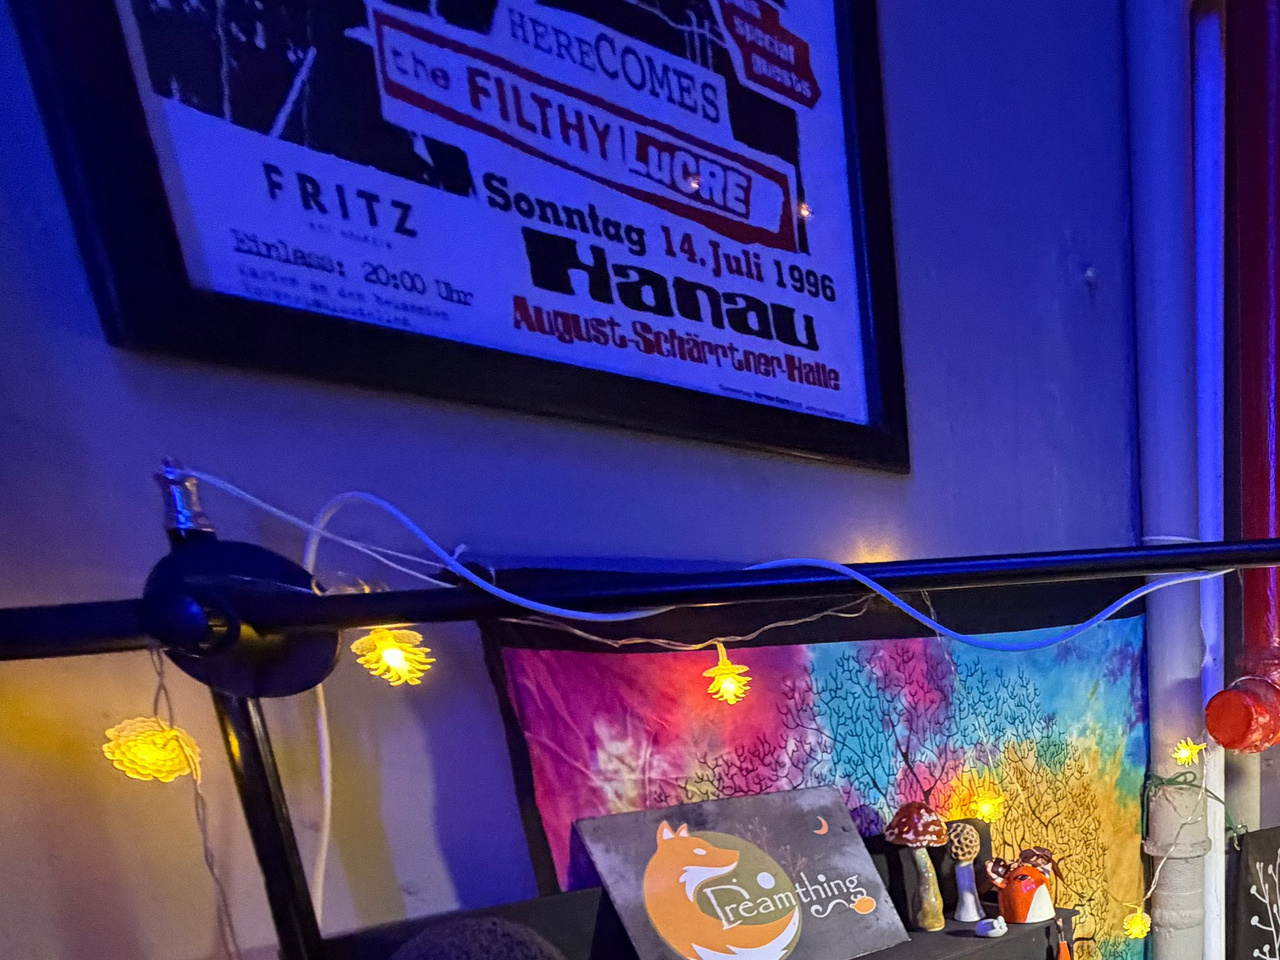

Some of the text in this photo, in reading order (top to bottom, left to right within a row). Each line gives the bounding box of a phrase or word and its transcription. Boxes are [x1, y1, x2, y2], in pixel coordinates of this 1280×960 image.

[389, 47, 451, 91] the
[466, 65, 611, 161] FILTHY
[262, 161, 418, 239] FRITZ
[481, 172, 648, 256] Sonntag
[772, 258, 837, 303] 1996
[361, 260, 427, 297] 20:00
[434, 278, 475, 308] Uhr
[520, 225, 820, 352] Hanau
[702, 871, 868, 931] Dreamthing
